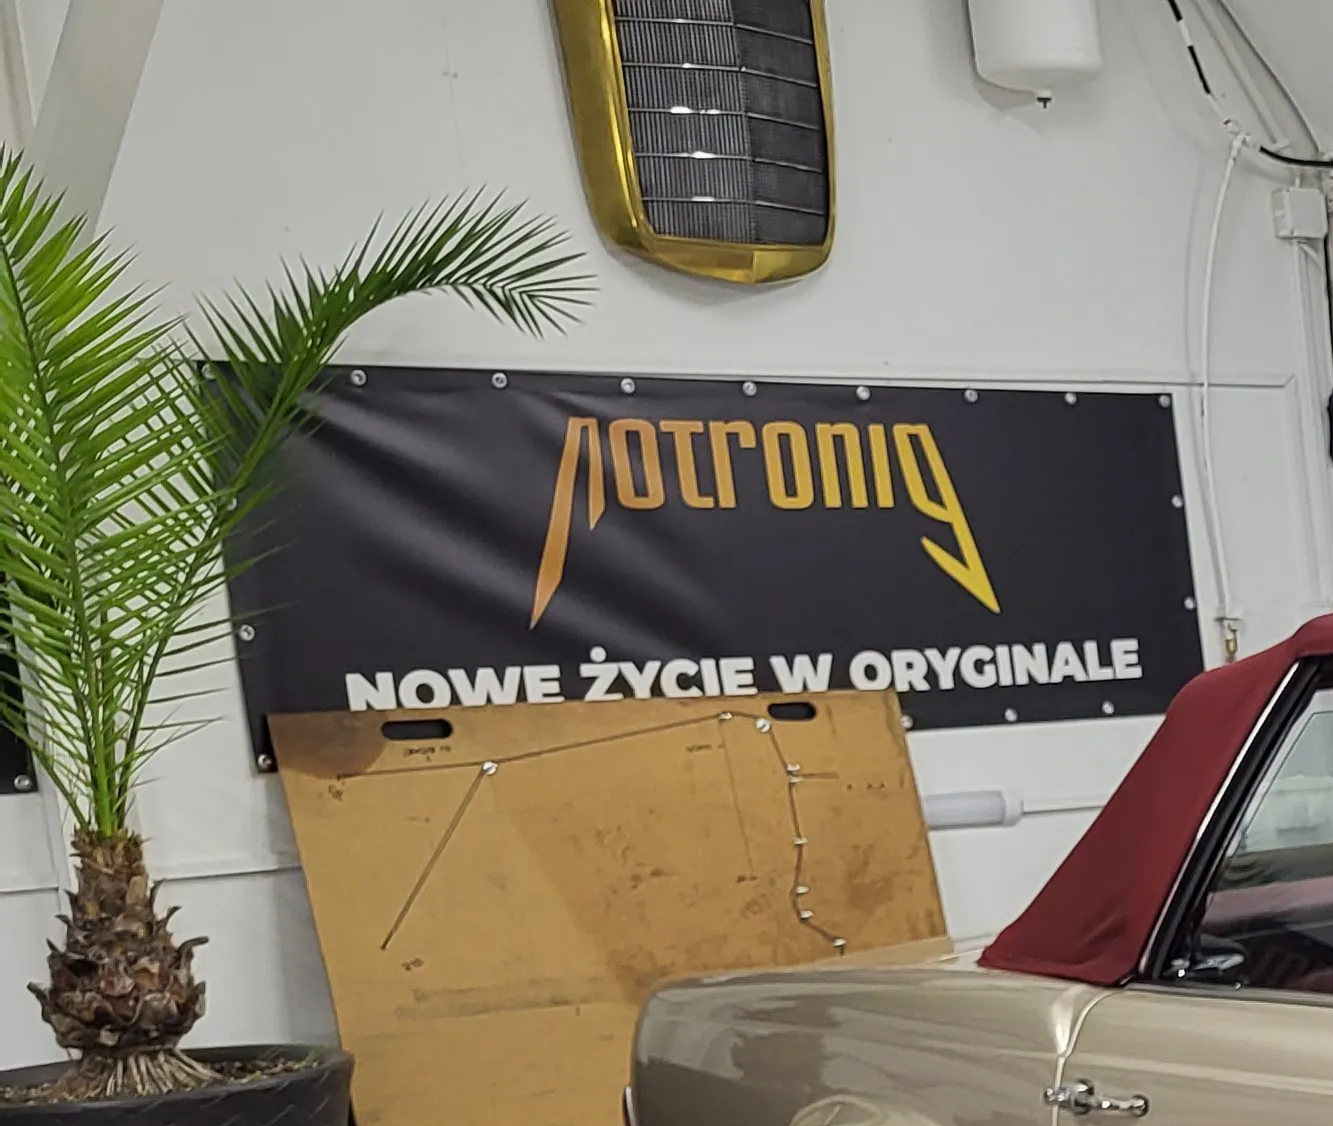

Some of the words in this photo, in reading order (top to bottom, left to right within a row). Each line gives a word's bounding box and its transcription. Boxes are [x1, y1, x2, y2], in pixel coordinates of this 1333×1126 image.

[345, 664, 565, 712] NOWE
[579, 646, 759, 702] ŻYCIE
[769, 653, 834, 694] W
[848, 637, 1143, 693] ORYGINALE
